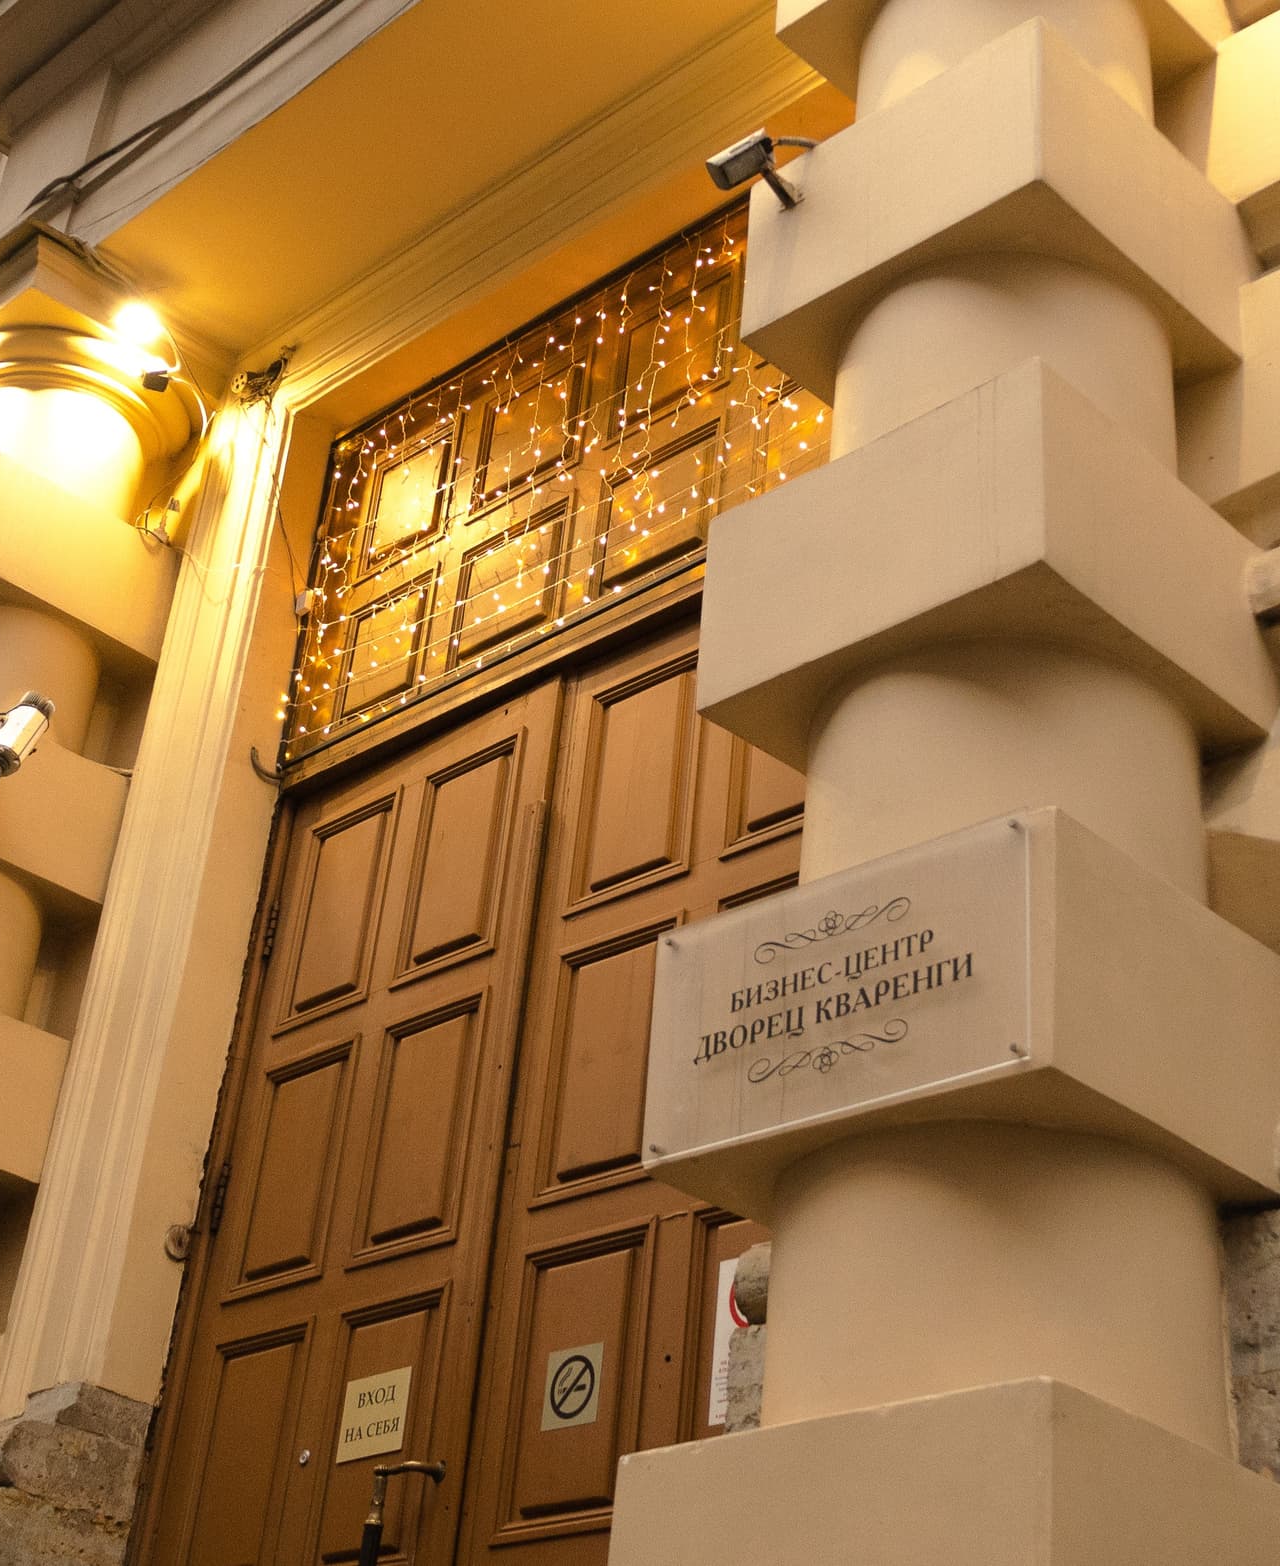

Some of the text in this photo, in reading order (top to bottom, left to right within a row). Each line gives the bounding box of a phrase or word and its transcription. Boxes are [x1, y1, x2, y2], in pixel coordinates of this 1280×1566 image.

[730, 929, 934, 1013] БИЗНЕС-ЦЕНТР
[693, 953, 974, 1065] ДВОРЕЦ КВАРЕНГИ
[357, 1384, 396, 1409] ВХОД
[344, 1416, 400, 1443] НА СЕБЯ
